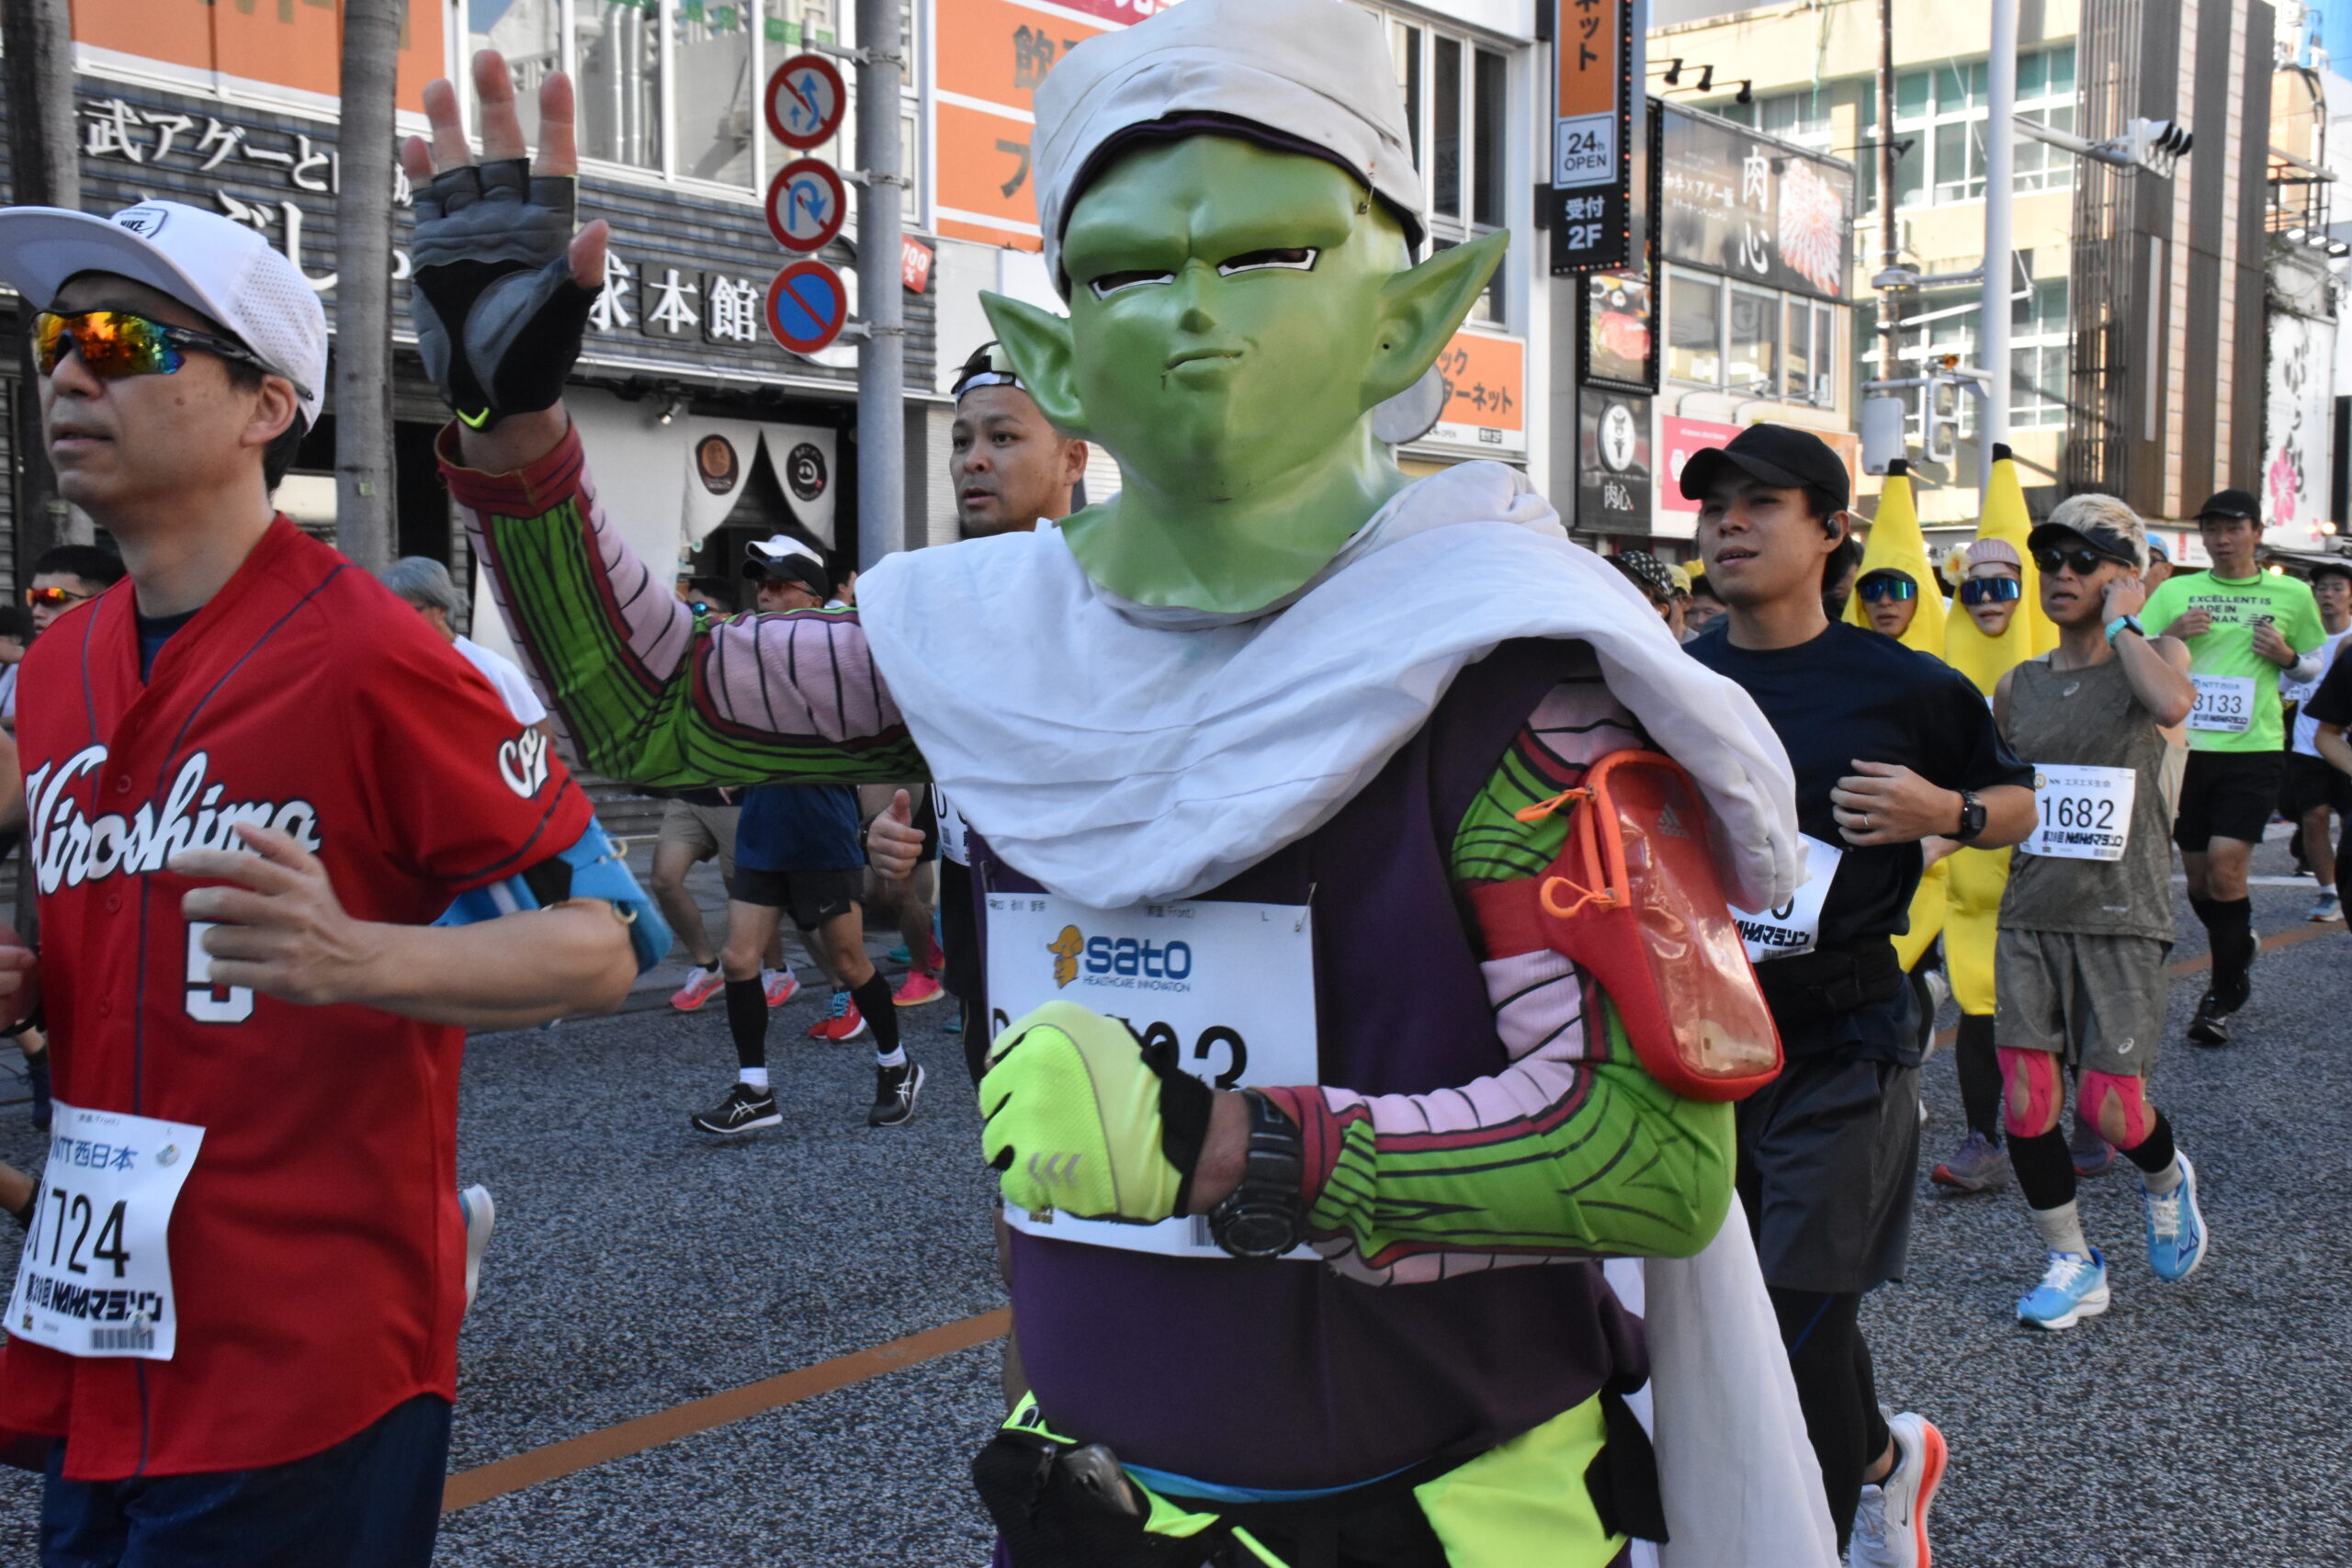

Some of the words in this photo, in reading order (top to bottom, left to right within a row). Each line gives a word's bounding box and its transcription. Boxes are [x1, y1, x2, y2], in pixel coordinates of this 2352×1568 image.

[1564, 153, 1607, 172] OPEN
[1566, 194, 1605, 221] 受付
[1567, 223, 1602, 250] 2F
[2188, 594, 2257, 605] EXCELLENT
[2259, 597, 2272, 605] IS
[2224, 604, 2237, 613] IN
[2192, 693, 2242, 715] 3133
[26, 744, 322, 896] Hiroshima
[2041, 795, 2115, 829] 1682
[1085, 935, 1193, 980] sato
